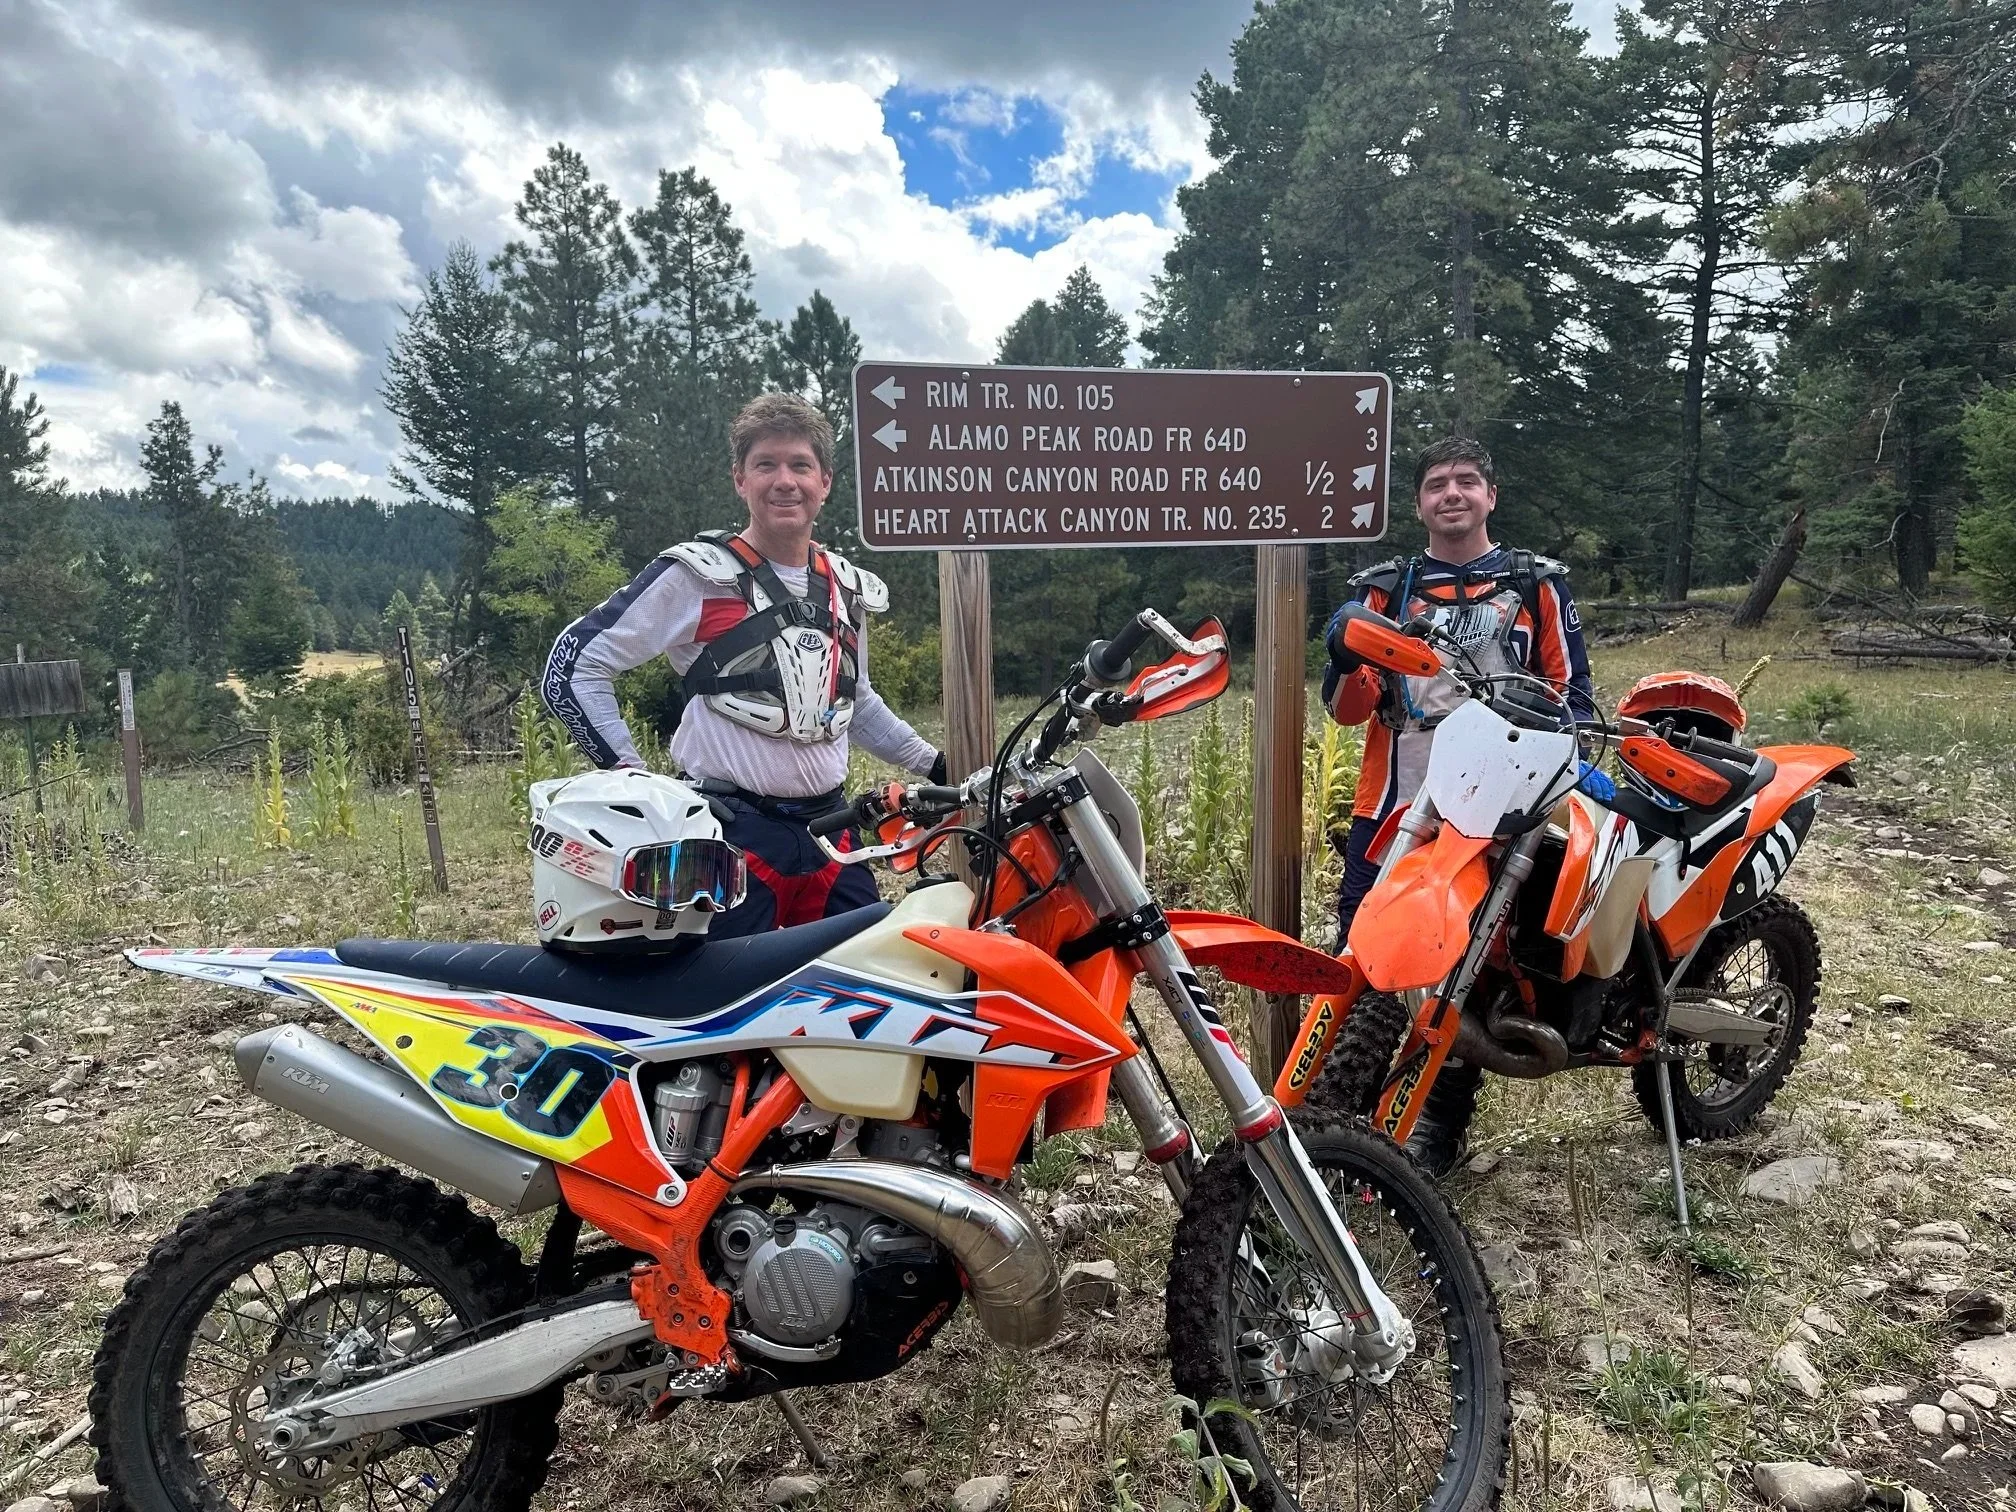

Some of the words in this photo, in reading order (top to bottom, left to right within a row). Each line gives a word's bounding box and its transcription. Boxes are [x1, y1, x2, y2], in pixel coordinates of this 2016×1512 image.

[926, 381, 968, 408] RIM
[980, 382, 1015, 409] TR.
[1027, 383, 1065, 410] NO.
[1076, 384, 1114, 411] 105
[928, 424, 1009, 450] ALAMO
[1022, 426, 1082, 452] PEAK
[1094, 426, 1153, 452] ROAD
[1166, 427, 1192, 452] FR
[1204, 427, 1247, 452] 64D
[1365, 427, 1379, 452] 3
[873, 466, 992, 492] ATKINSON
[1005, 466, 1098, 492] CANYON
[1111, 467, 1169, 492] ROAD
[1181, 467, 1208, 492] FR
[1218, 466, 1261, 492] 640
[874, 508, 950, 535] HEART
[962, 508, 1048, 534] ATTACK
[1060, 507, 1150, 533] CANYON
[1161, 506, 1192, 531] TR.
[1203, 505, 1238, 531] NO.
[1248, 505, 1286, 530] 235
[1320, 505, 1333, 529] 2
[530, 821, 601, 877] 00%
[1751, 818, 1799, 899] 411
[539, 905, 558, 926] BELL
[1161, 976, 1183, 1005] XACT
[281, 1066, 331, 1095] KTM
[429, 1023, 618, 1140] 30
[985, 1093, 1026, 1111] KTM
